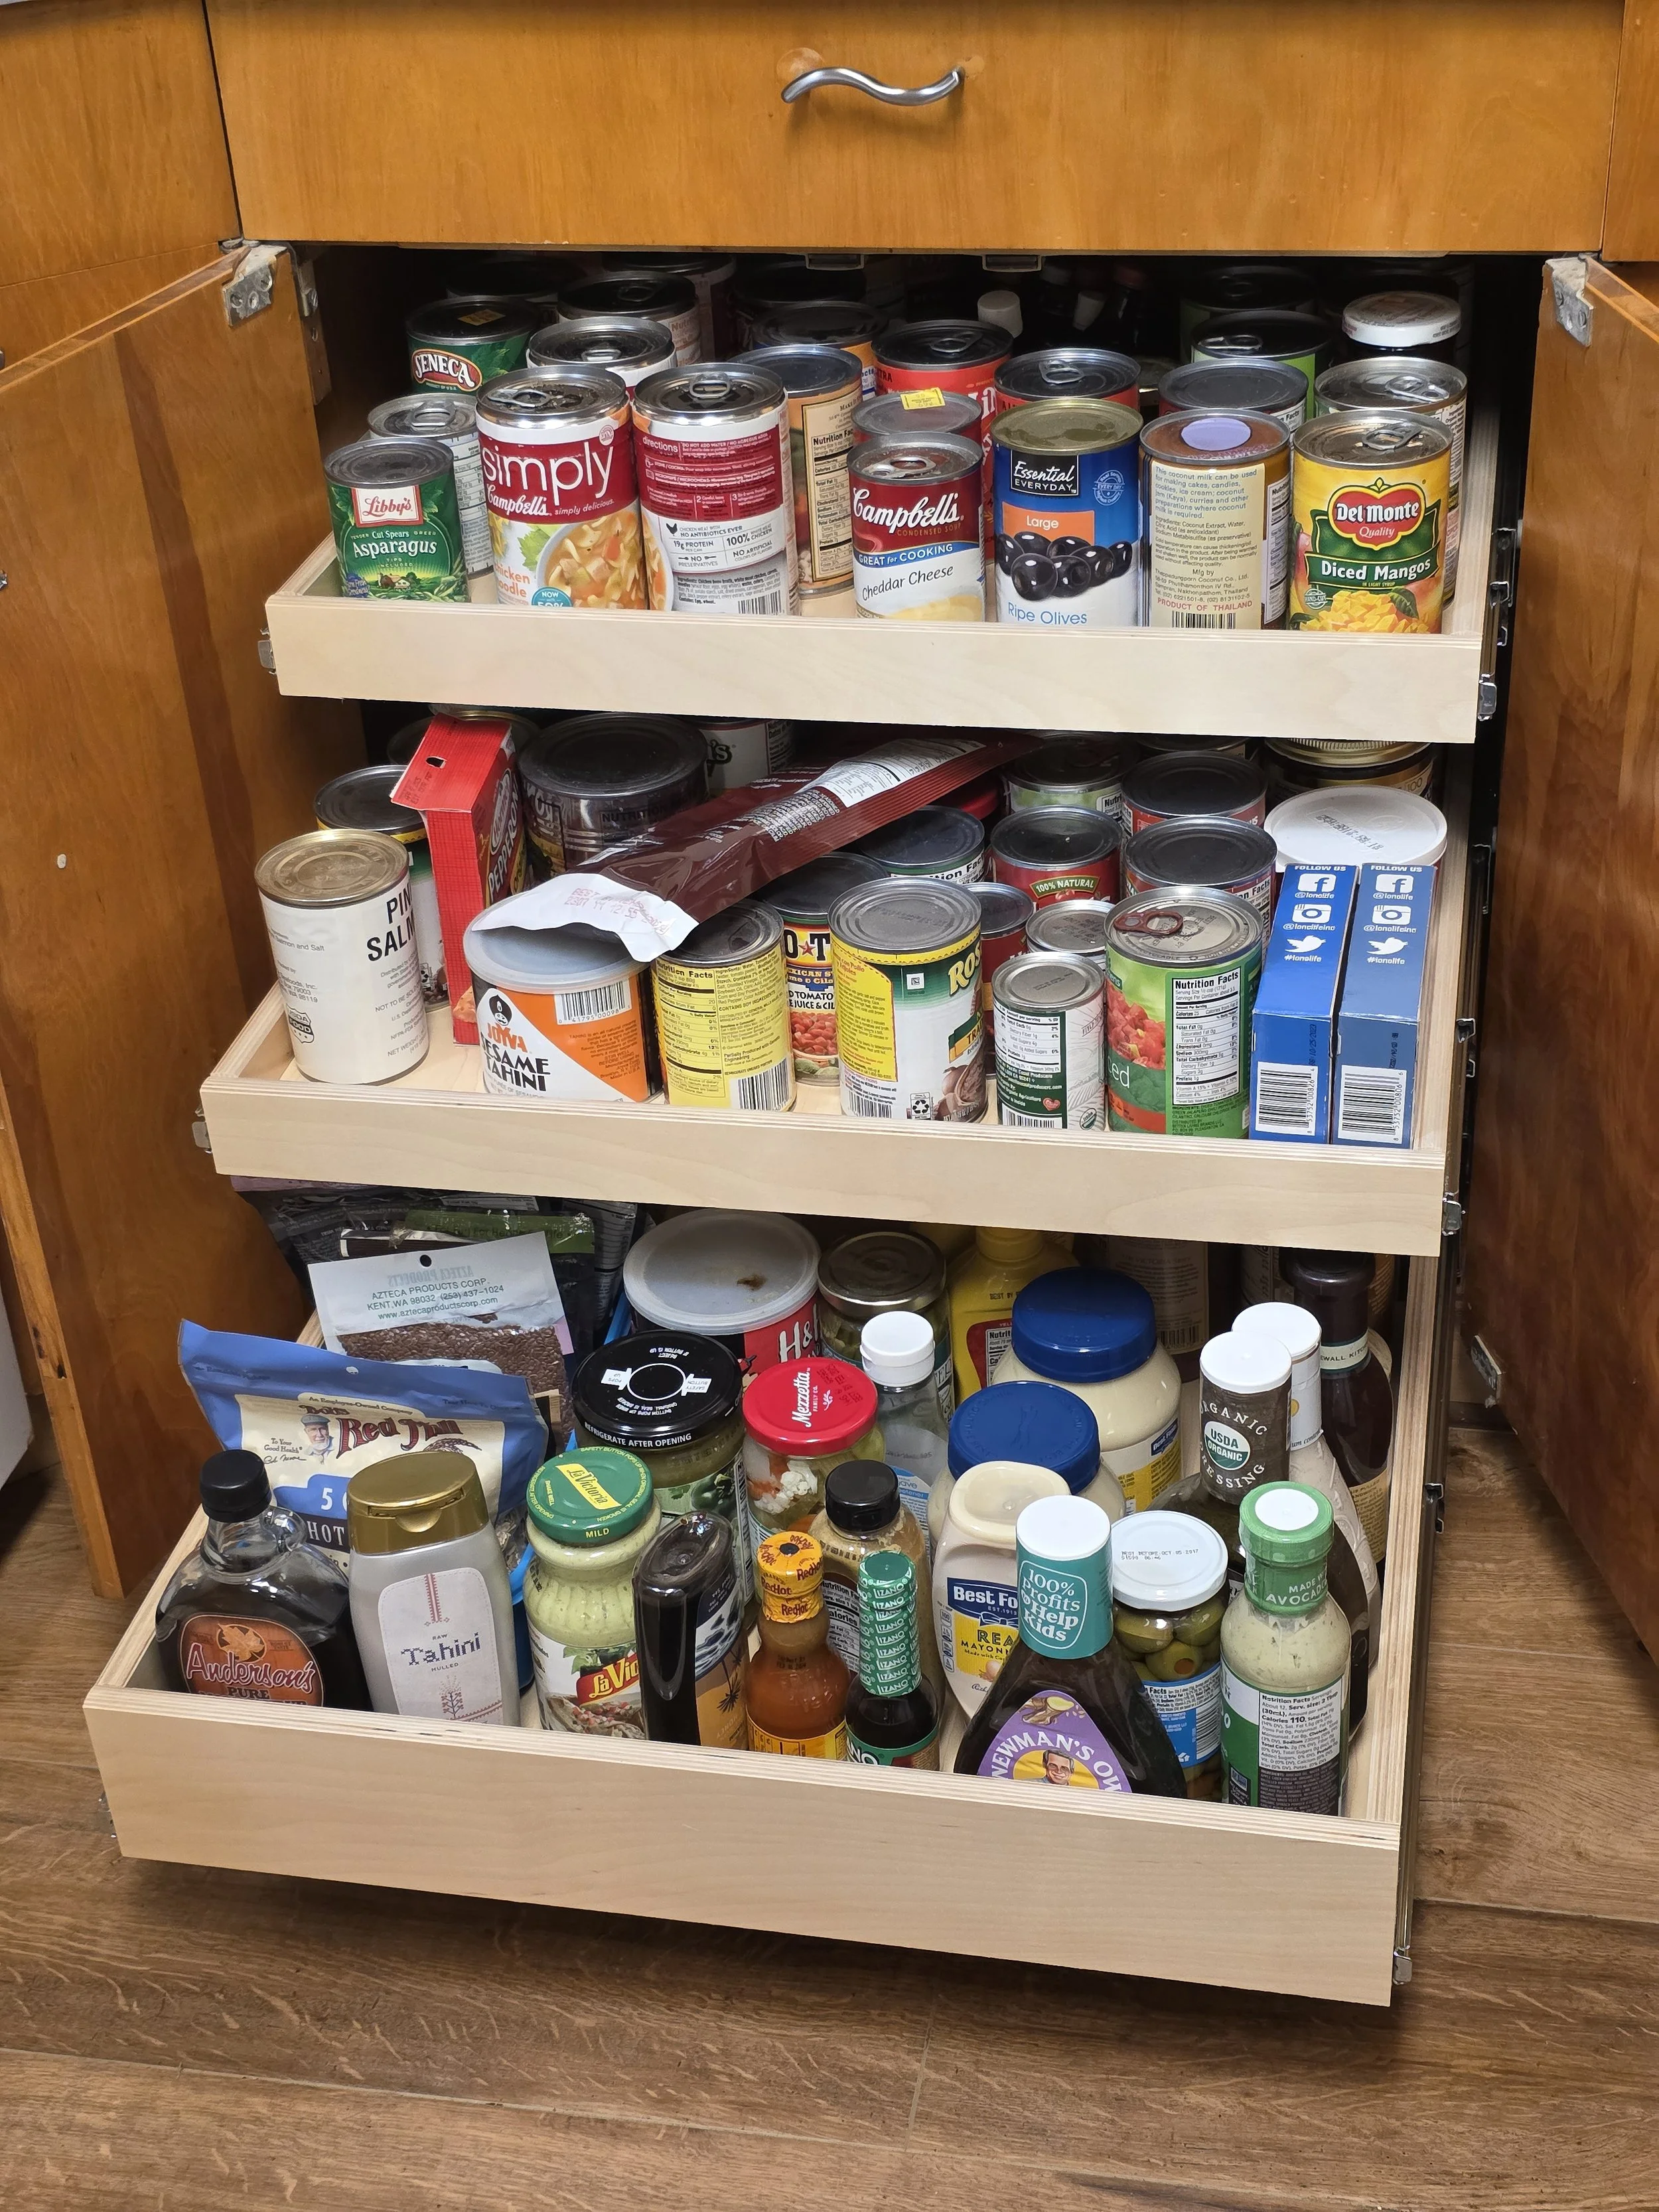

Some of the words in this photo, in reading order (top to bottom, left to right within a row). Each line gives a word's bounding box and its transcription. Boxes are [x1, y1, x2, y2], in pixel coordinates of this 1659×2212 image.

[415, 352, 474, 388] SENECA
[1286, 410, 1300, 421] Facts
[642, 435, 678, 453] directions
[813, 432, 843, 446] Nutrition
[482, 441, 614, 506] simply
[1014, 461, 1076, 483] Essential
[1155, 466, 1167, 476] This
[1168, 470, 1195, 480] coconut
[1197, 472, 1212, 480] milk
[1241, 469, 1258, 479] used
[1015, 479, 1072, 492] EVERYDAY
[1155, 483, 1178, 494] cookies,
[1164, 477, 1187, 488] making
[1188, 480, 1210, 489] cakes,
[1211, 480, 1241, 489] candies,
[363, 495, 413, 517] Libby's
[485, 483, 553, 516] Campbell's
[554, 506, 581, 516] simply
[1155, 497, 1193, 511] preparations
[1166, 493, 1188, 504] (Kaya),
[853, 487, 960, 535] Campbell's
[1174, 510, 1204, 520] required.
[1336, 502, 1364, 522] Del
[1366, 501, 1419, 522] Monte
[690, 529, 727, 538] ANTIBIOTICS
[727, 525, 743, 534] EVER
[1026, 514, 1059, 531] Large
[372, 530, 386, 540] Cut
[386, 530, 410, 539] Spears
[726, 533, 751, 547] 100%
[897, 527, 944, 537] CONDENSED
[1359, 527, 1396, 539] Quality
[353, 539, 438, 559] Asparagus
[746, 540, 773, 555] ARTIFICIAL
[859, 553, 886, 567] GREAT
[886, 555, 899, 563] for
[900, 544, 954, 562] COOKING
[1321, 560, 1367, 581] Diced
[1374, 558, 1431, 581] Mangos
[496, 581, 527, 597] oodle
[862, 576, 905, 602] Cheddar
[908, 564, 954, 586] Cheese
[1008, 601, 1036, 622] Ripe
[1040, 611, 1088, 625] Olives
[1157, 597, 1192, 611] PRODUCT
[1213, 600, 1253, 611] THAILAND
[488, 790, 520, 903] PEPPERON
[1035, 881, 1056, 893] 100%
[1057, 878, 1095, 889] NATURAL
[1252, 878, 1271, 899] Facts
[386, 882, 412, 924] PIN
[367, 912, 416, 962] SALM
[688, 970, 713, 979] Facts
[849, 962, 865, 973] Pollo
[1175, 979, 1214, 990] Nutrition
[1217, 971, 1239, 984] Facts
[794, 991, 833, 1001] TOMATO
[794, 1000, 815, 1010] JUICE
[375, 1002, 388, 1013] NOT
[598, 1009, 620, 1019] 00098
[487, 1023, 528, 1054] JOYVA
[480, 1031, 551, 1076] SESAME
[484, 1052, 547, 1092] TAHINI
[372, 1290, 407, 1300] AZTECA
[409, 1281, 459, 1294] PRODUCTS
[461, 1277, 490, 1289] CORP.
[409, 1294, 436, 1305] 98032
[463, 1285, 504, 1297] 437-1024
[378, 1296, 498, 1320] www.aztecaproductscorp.com
[319, 1396, 380, 1412] Employee-Owned
[381, 1405, 413, 1416] Company
[791, 1370, 812, 1428] Mezzetta
[336, 1418, 400, 1459] Red
[585, 1421, 626, 1446] REFRIGERATE
[628, 1439, 653, 1447] AFTER
[655, 1433, 692, 1447] OPENING
[1210, 1427, 1239, 1449] USDA
[264, 1444, 279, 1453] Good
[1208, 1441, 1243, 1462] ORGANIC
[575, 1471, 609, 1505] Victoria
[321, 1487, 333, 1511] 5
[307, 1520, 345, 1544] HOT
[585, 1527, 610, 1539] MILD
[873, 1583, 904, 1598] LIZANO
[1028, 1568, 1075, 1597] 100%
[1289, 1578, 1317, 1593] MADE
[954, 1585, 995, 1605] Best
[1021, 1576, 1081, 1611] Profits
[781, 1601, 808, 1617] RedHot
[1031, 1596, 1079, 1630] Help
[1023, 1610, 1067, 1641] Kids
[875, 1631, 906, 1647] LIZANO
[977, 1629, 1015, 1647] REA
[400, 1632, 481, 1666] Tahini
[186, 1643, 315, 1694] Anderson's
[431, 1662, 459, 1672] HULLED
[876, 1655, 907, 1670] LIZANO
[877, 1667, 909, 1683] LIZANO
[226, 1686, 271, 1700] PURE
[589, 1674, 613, 1700] La
[877, 1679, 909, 1696] LIZANO
[1149, 1686, 1167, 1695] Facts
[1262, 1694, 1291, 1704] Nutrition
[1262, 1715, 1289, 1724] Calories
[991, 1730, 1095, 1780] NEWMAN'S
